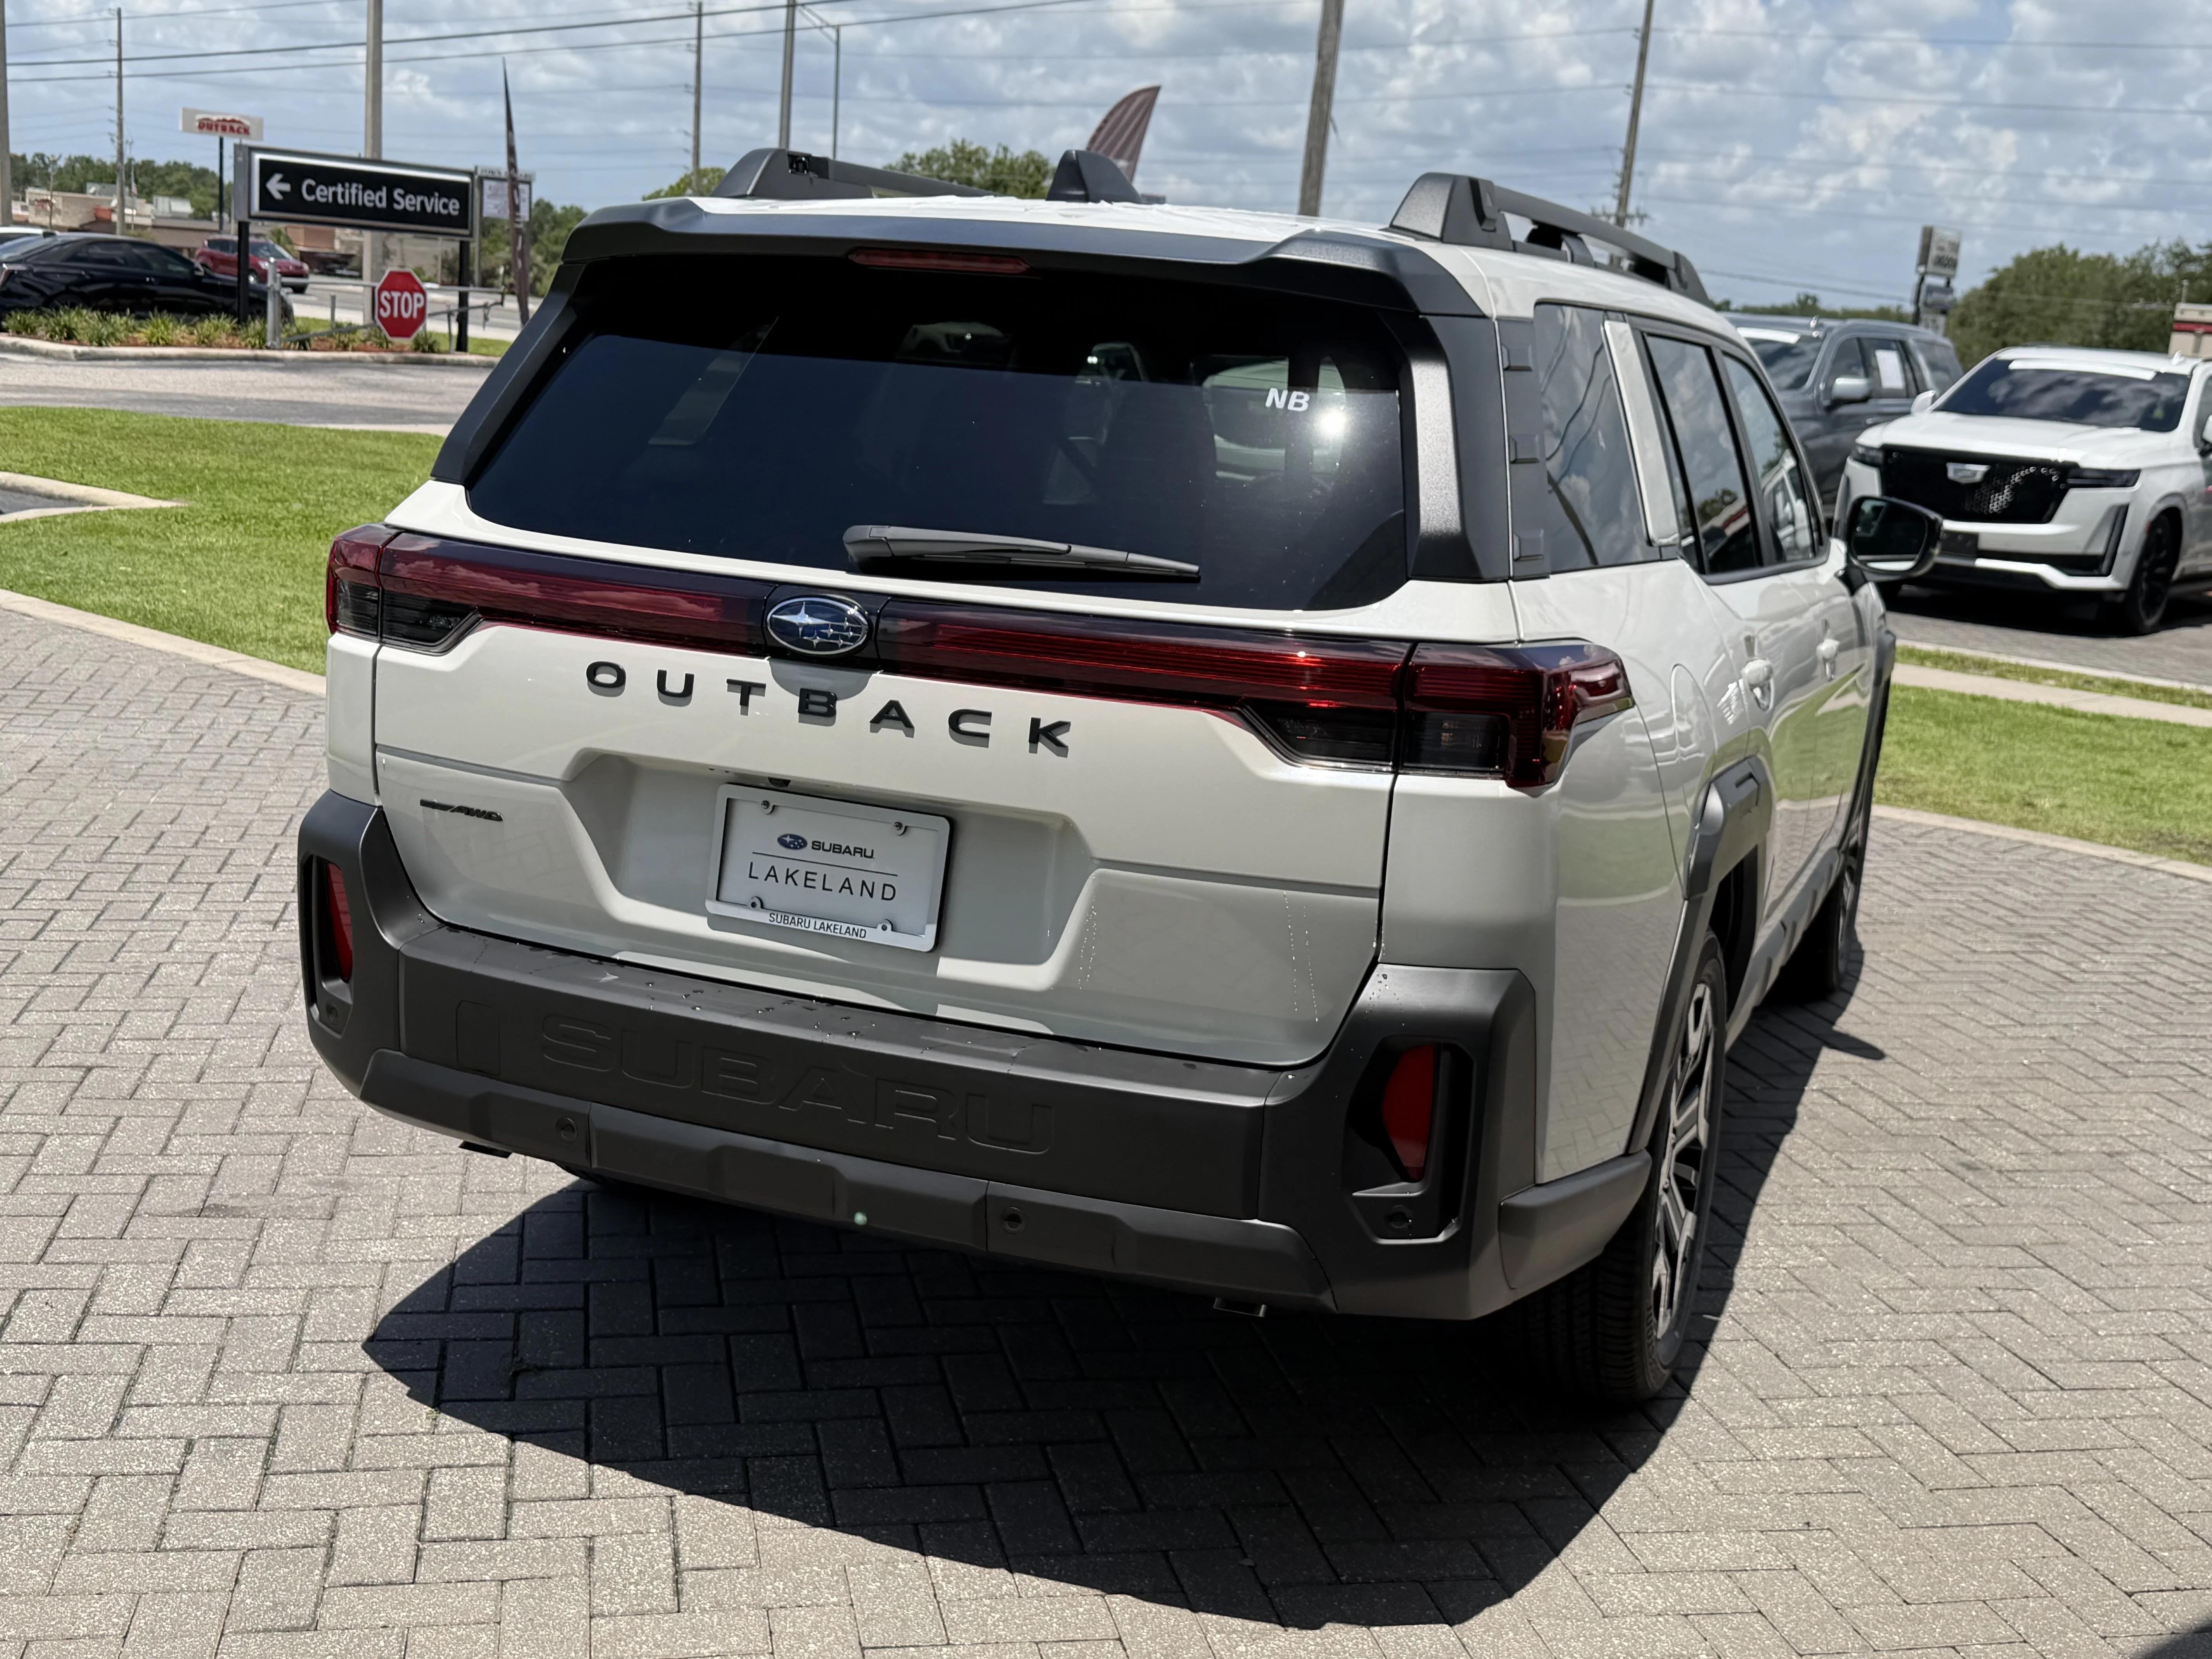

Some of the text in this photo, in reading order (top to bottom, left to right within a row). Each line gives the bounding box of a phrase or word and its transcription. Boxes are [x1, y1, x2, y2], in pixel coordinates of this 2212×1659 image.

[301, 178, 387, 208] Certified
[393, 188, 460, 216] Service
[380, 290, 424, 319] STOP
[1265, 388, 1310, 411] NB
[586, 661, 1071, 748] OUTBACK
[811, 840, 874, 859] SUBARU
[749, 862, 896, 901] LAKELAND
[769, 913, 866, 938] SUBARU LAKELAND
[541, 1014, 1054, 1155] SUBARU
